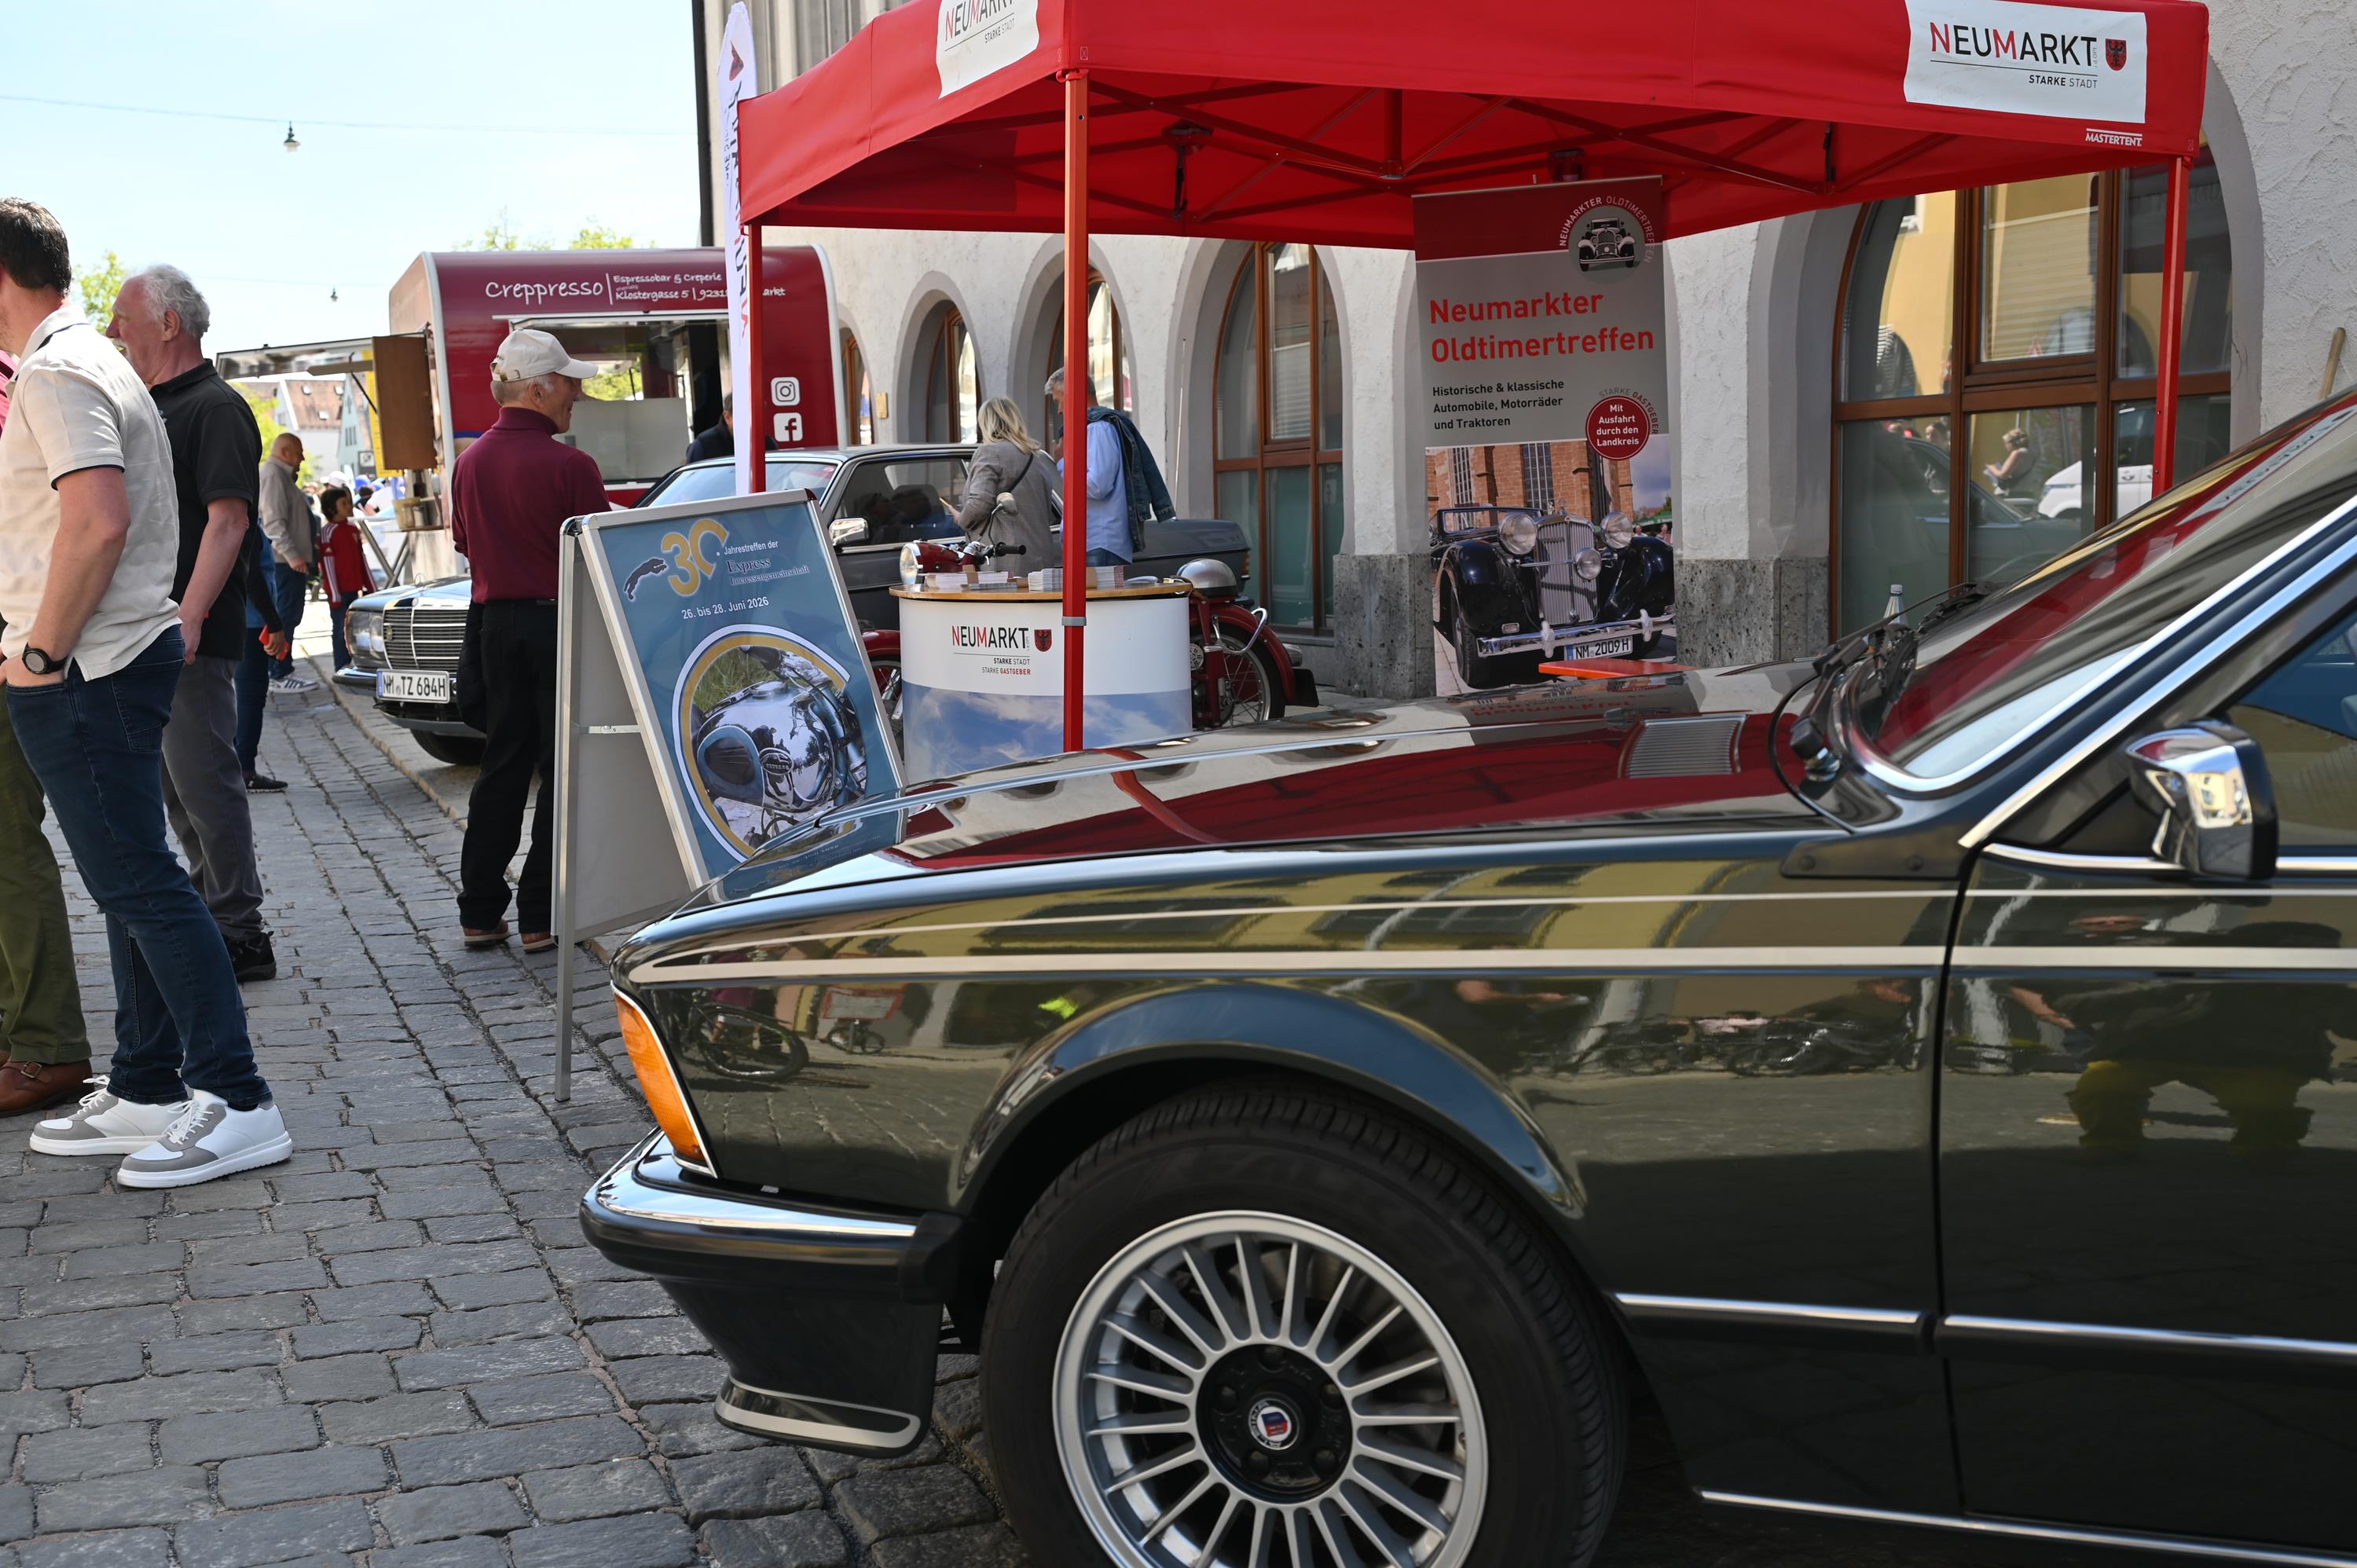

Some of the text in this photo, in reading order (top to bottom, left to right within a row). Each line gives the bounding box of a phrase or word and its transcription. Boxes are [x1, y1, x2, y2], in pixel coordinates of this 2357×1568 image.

[945, 0, 1012, 42] NEUMAR
[984, 18, 1015, 43] STARKE STADT
[1930, 21, 2097, 67] NEUMARKT
[2029, 75, 2098, 89] STARKE STADT
[2085, 132, 2143, 147] MASTERTENT
[1559, 195, 1655, 263] NEUMARKTER OLDTIMERTREFFEN
[613, 273, 672, 284] Espressobar
[683, 273, 722, 284] Creperie
[615, 290, 680, 302] Klostergasse
[762, 286, 786, 296] arkt
[1430, 291, 1604, 324] Neumarkter
[1431, 327, 1654, 363] Oldtimertreffen
[1432, 379, 1564, 397] Historische & klassische
[1433, 396, 1563, 413] Automobile, Motorräder
[1598, 387, 1659, 434] STARKE GASTGEBER
[1610, 404, 1623, 412] Mit
[1434, 417, 1511, 430] und Traktoren
[1599, 415, 1636, 424] Ausfahrt
[1596, 427, 1621, 435] durch
[1597, 438, 1639, 446] Landkreis
[724, 542, 767, 555] Jahrestreffen
[768, 540, 779, 549] der
[727, 557, 771, 573] Express
[729, 563, 810, 585] Interessengemeinschaft
[681, 596, 769, 620] 26. bis 28. Juni 2026
[951, 625, 1029, 649] NEUMARKT
[1575, 645, 1589, 659] NM
[401, 676, 414, 695] TZ
[416, 677, 445, 698] 684H
